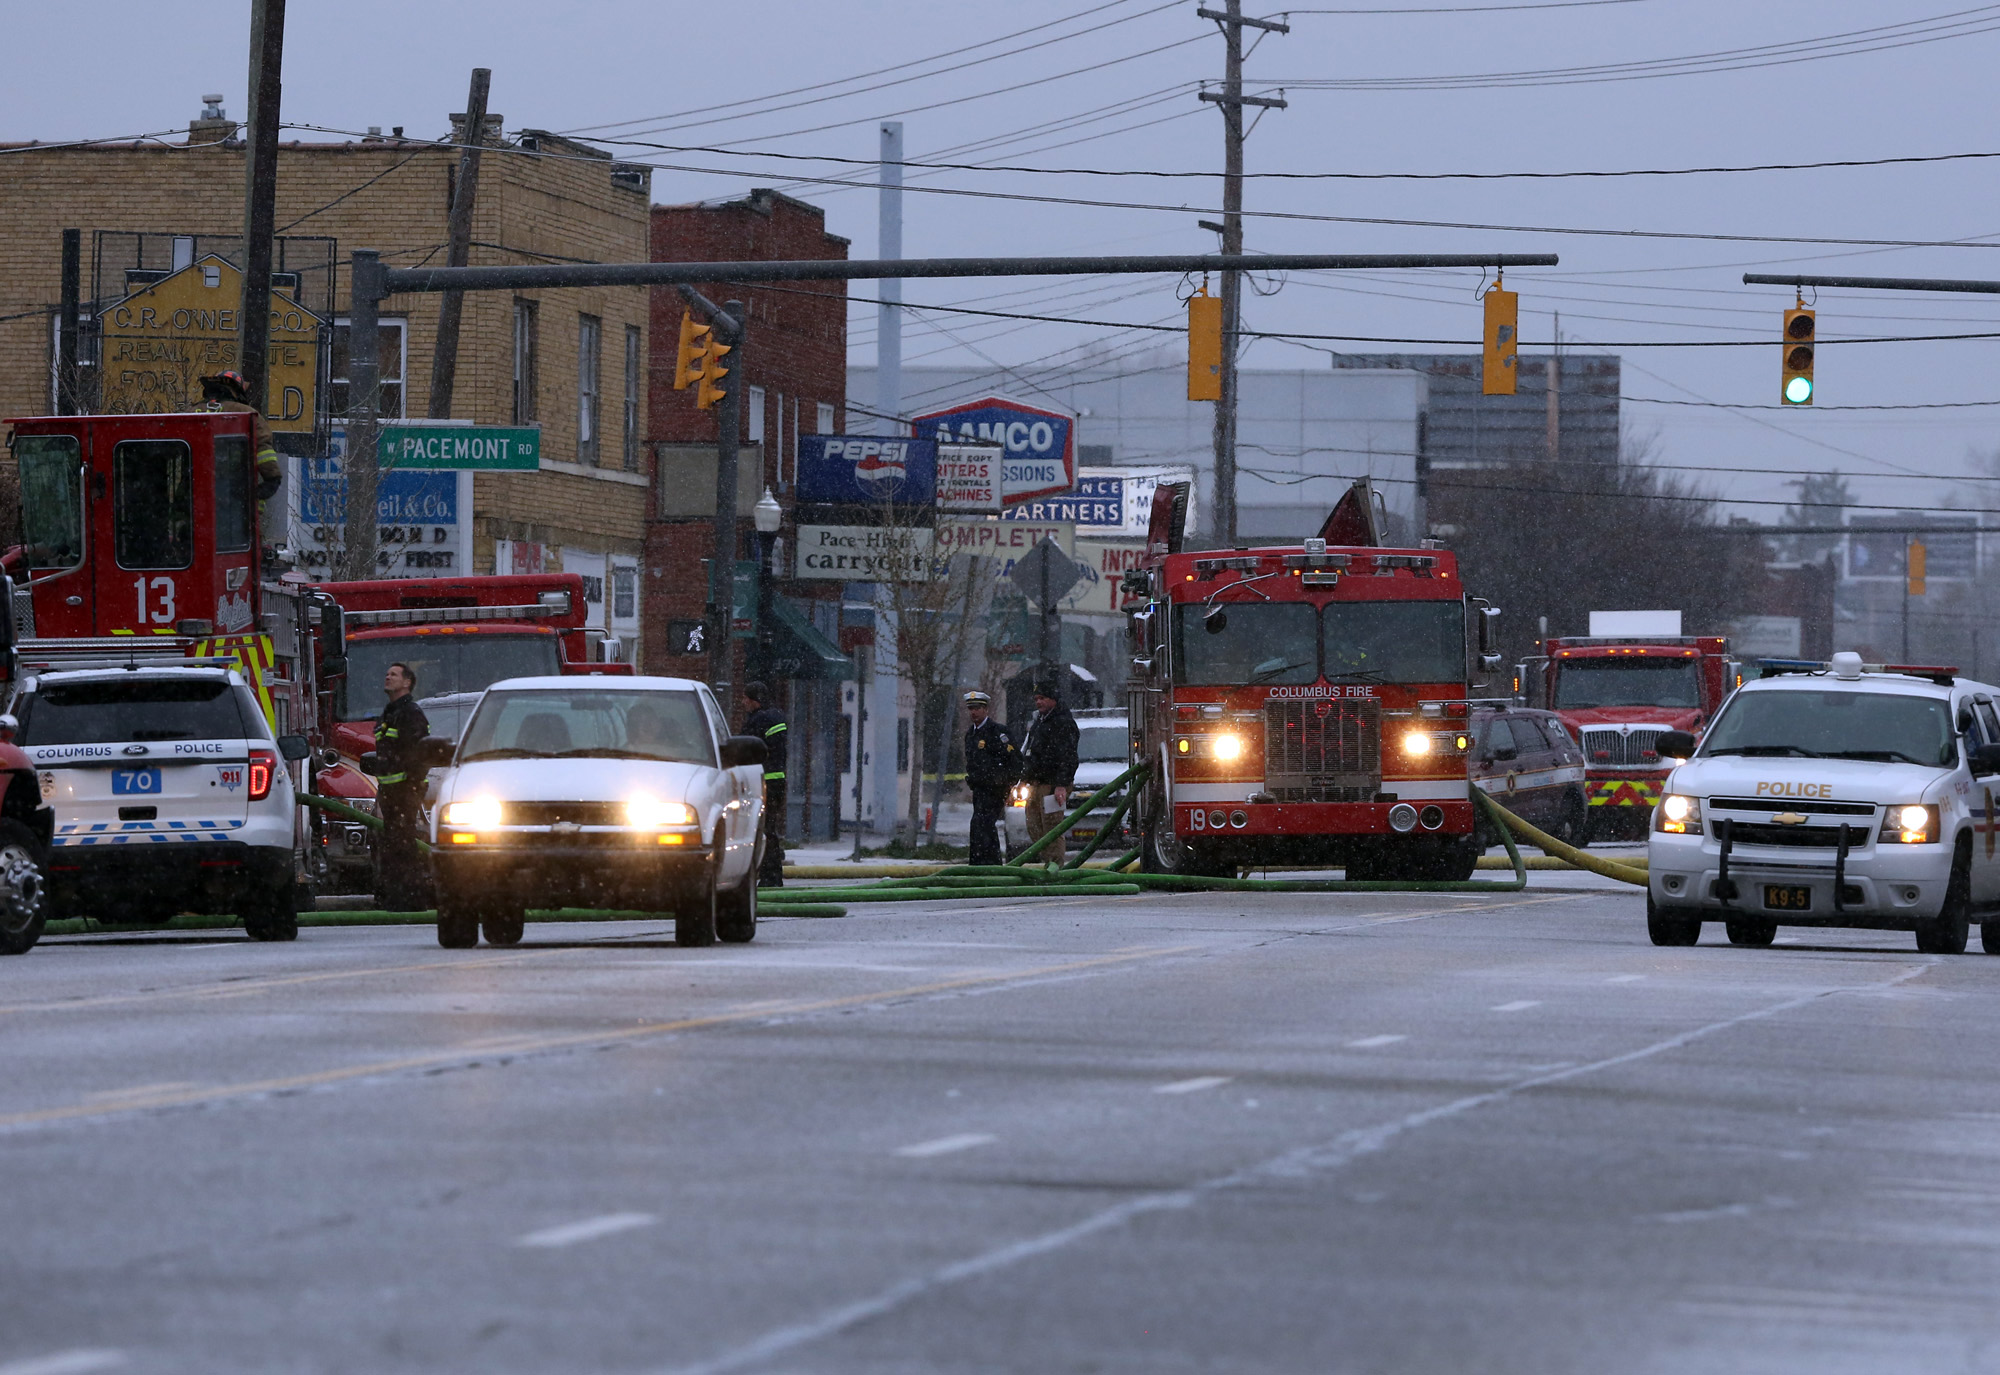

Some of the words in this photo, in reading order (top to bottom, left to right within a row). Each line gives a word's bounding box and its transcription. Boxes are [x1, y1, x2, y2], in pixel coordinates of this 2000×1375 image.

[204, 343, 301, 366] ESTE
[936, 421, 1054, 452] AAMCO
[386, 441, 396, 454] W
[403, 437, 511, 460] PACEMONT
[517, 443, 534, 456] RD
[823, 440, 909, 463] PEPSI
[936, 464, 989, 478] RITERS
[1002, 465, 1056, 482] SSIONS
[936, 488, 993, 501] ACHINES
[1081, 481, 1120, 494] NCE
[938, 527, 1060, 548] OMPLET
[804, 553, 923, 575] carryout
[1101, 548, 1146, 572] INCO
[133, 576, 176, 624] 13
[1269, 686, 1342, 698] COLUMBUS
[1345, 686, 1374, 697] FIRE
[36, 746, 113, 759] COLUMBUS
[174, 743, 224, 754] POLICE
[121, 772, 153, 792] 70
[221, 770, 241, 783] 911
[1755, 781, 1833, 799] POLICE
[1190, 808, 1206, 831] 19
